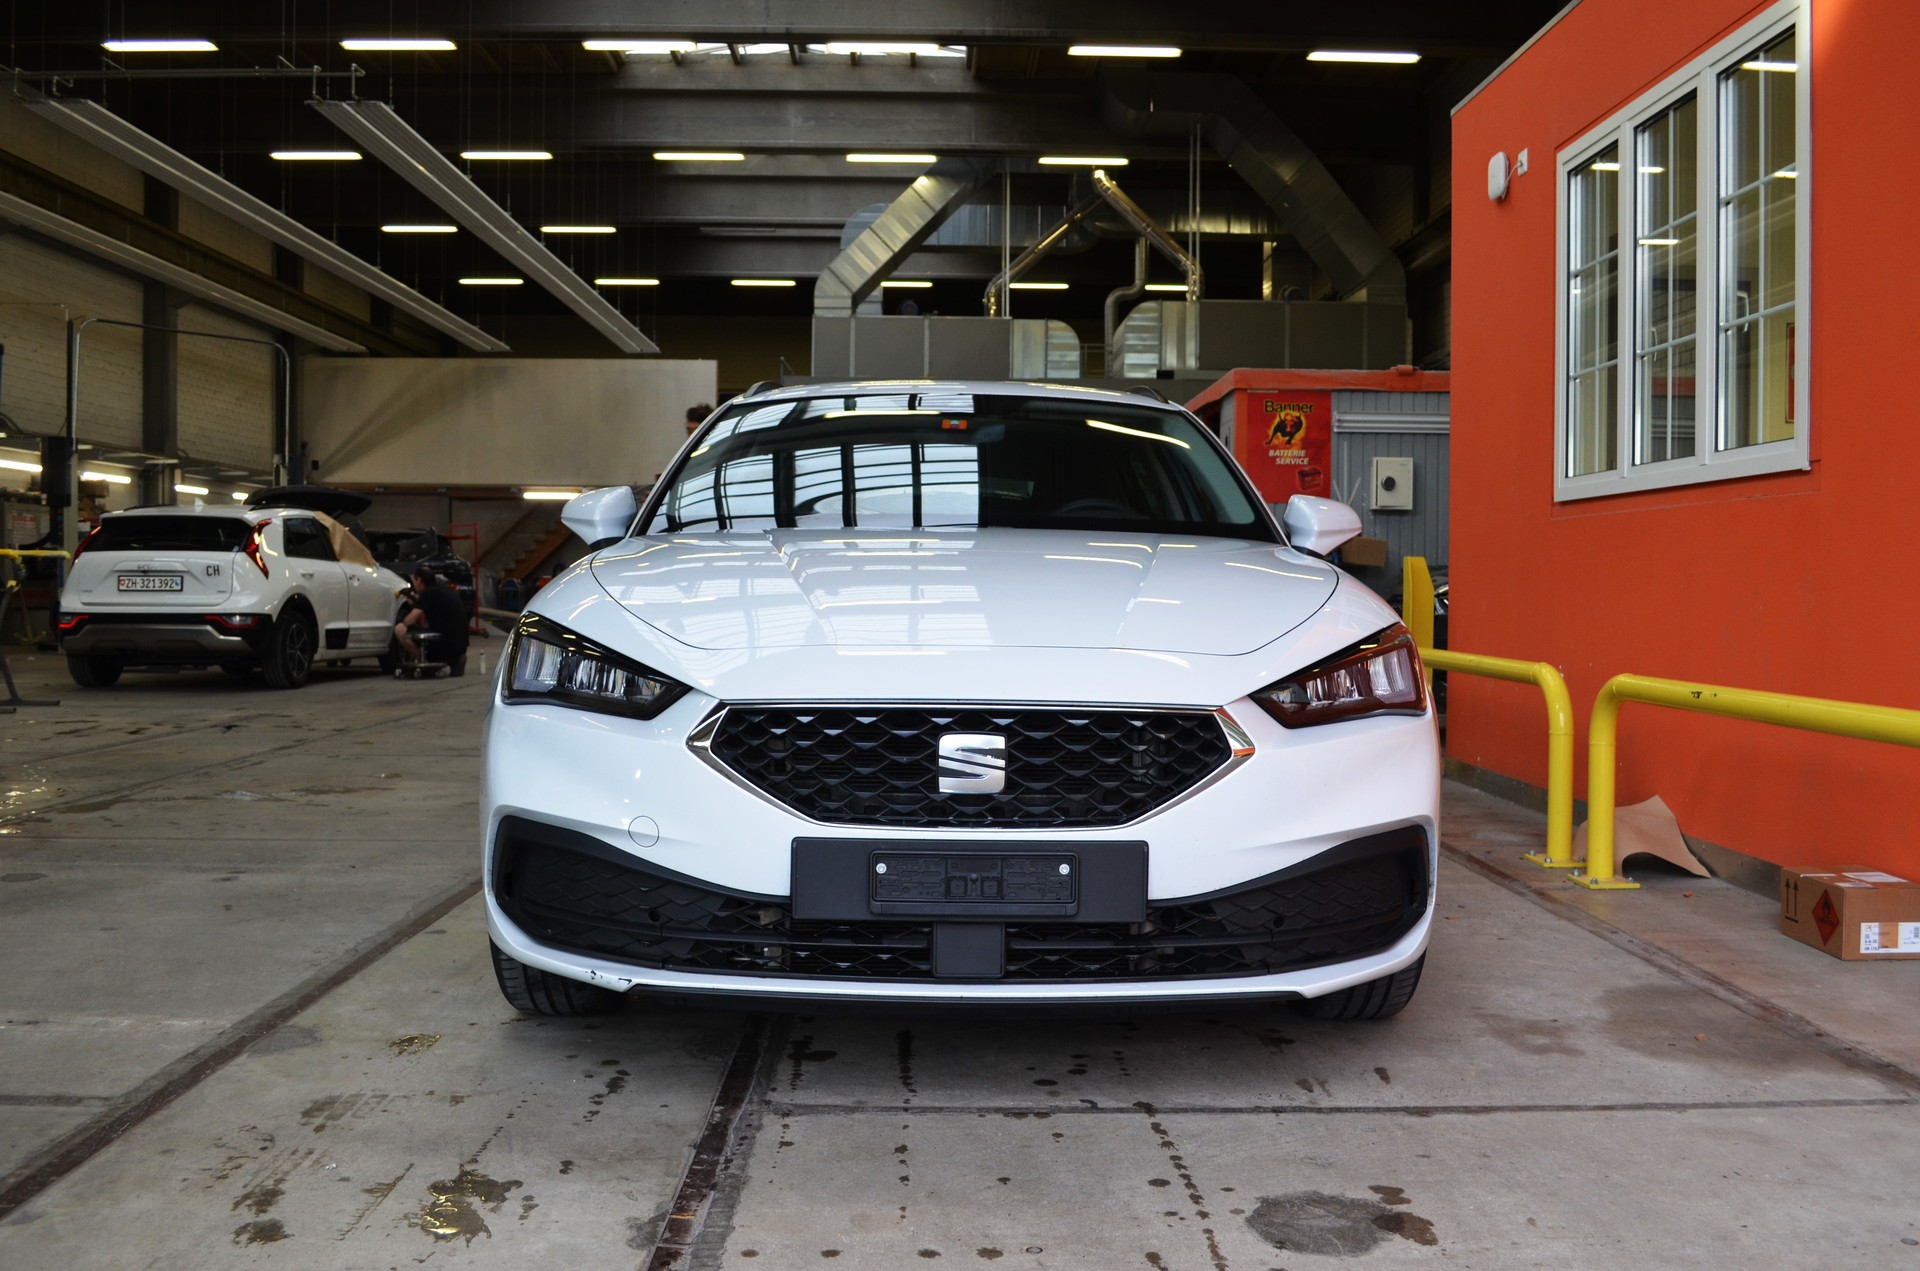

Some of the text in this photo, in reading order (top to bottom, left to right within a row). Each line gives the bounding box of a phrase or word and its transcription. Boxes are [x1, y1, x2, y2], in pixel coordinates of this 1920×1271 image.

[1264, 400, 1315, 413] Banner
[1268, 449, 1306, 457] BATTERIE
[1275, 457, 1309, 465] SERVICE
[206, 564, 220, 577] CH
